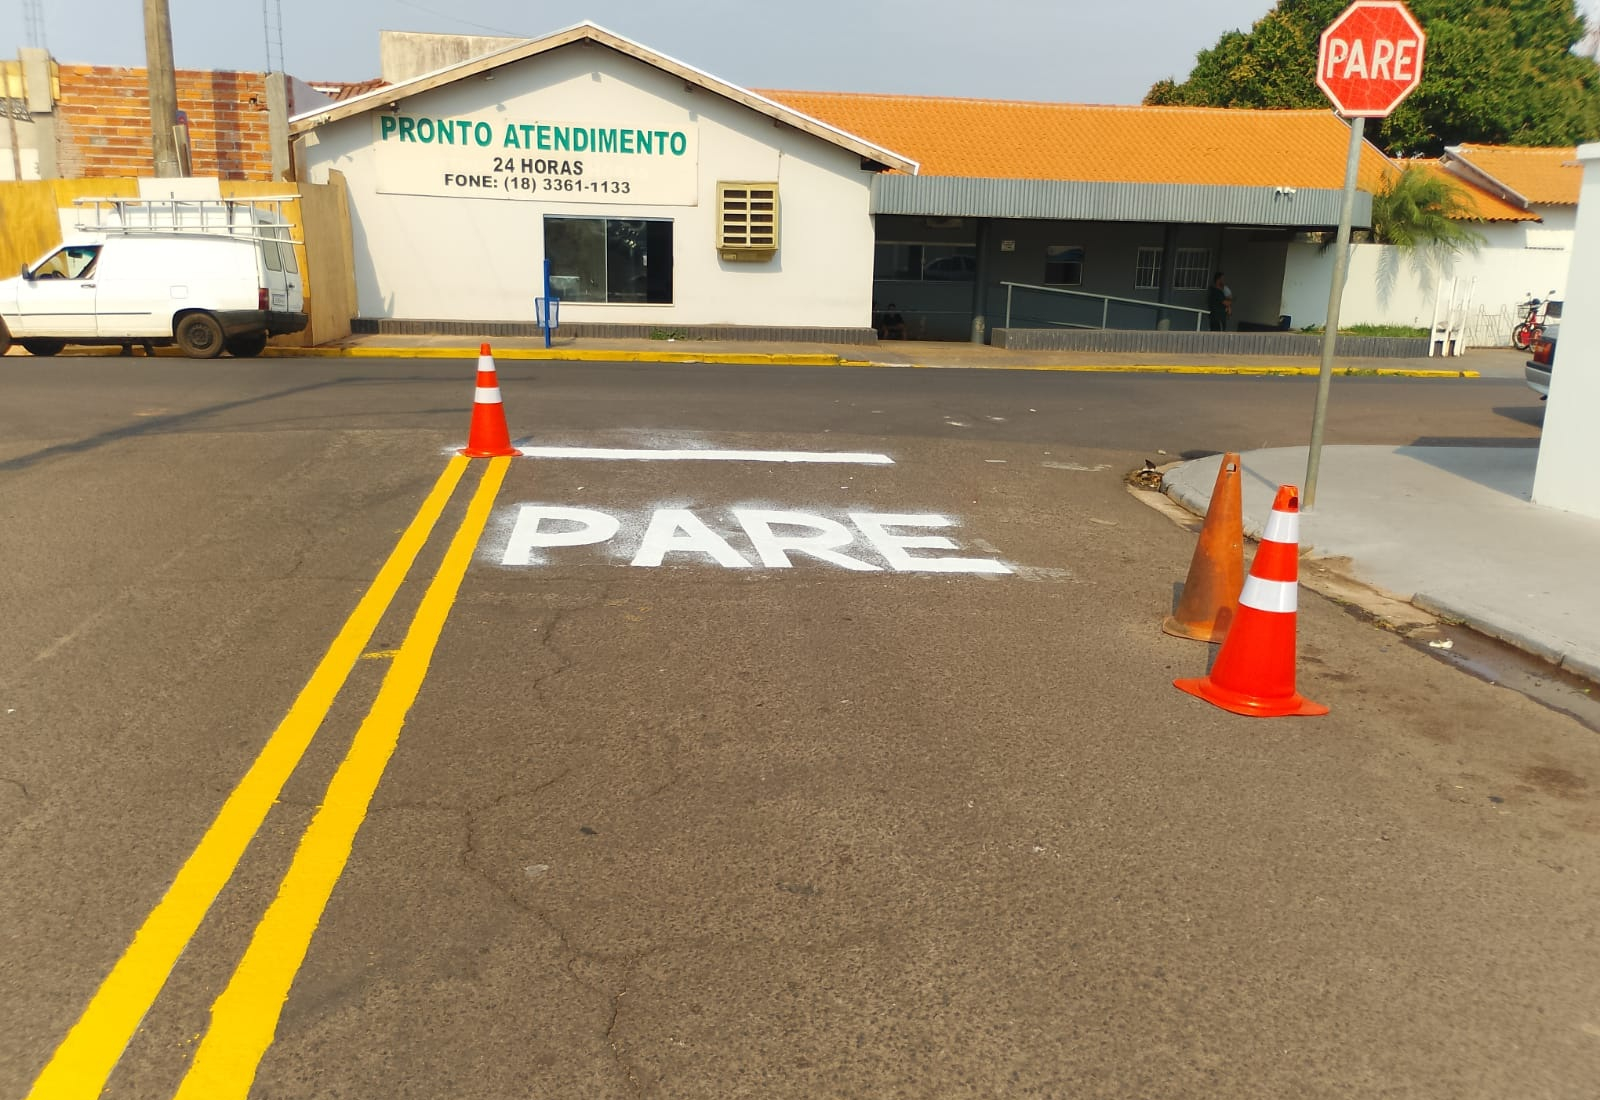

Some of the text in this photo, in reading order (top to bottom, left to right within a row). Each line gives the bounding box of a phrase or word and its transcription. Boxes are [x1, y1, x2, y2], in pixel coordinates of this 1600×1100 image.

[1326, 38, 1417, 81] PARE
[381, 115, 687, 156] PRONTO ATENDIMENTO
[444, 174, 631, 194] FONE: (18) 3361-1133
[493, 157, 584, 176] 24 HORAS
[500, 505, 1015, 575] PARE
